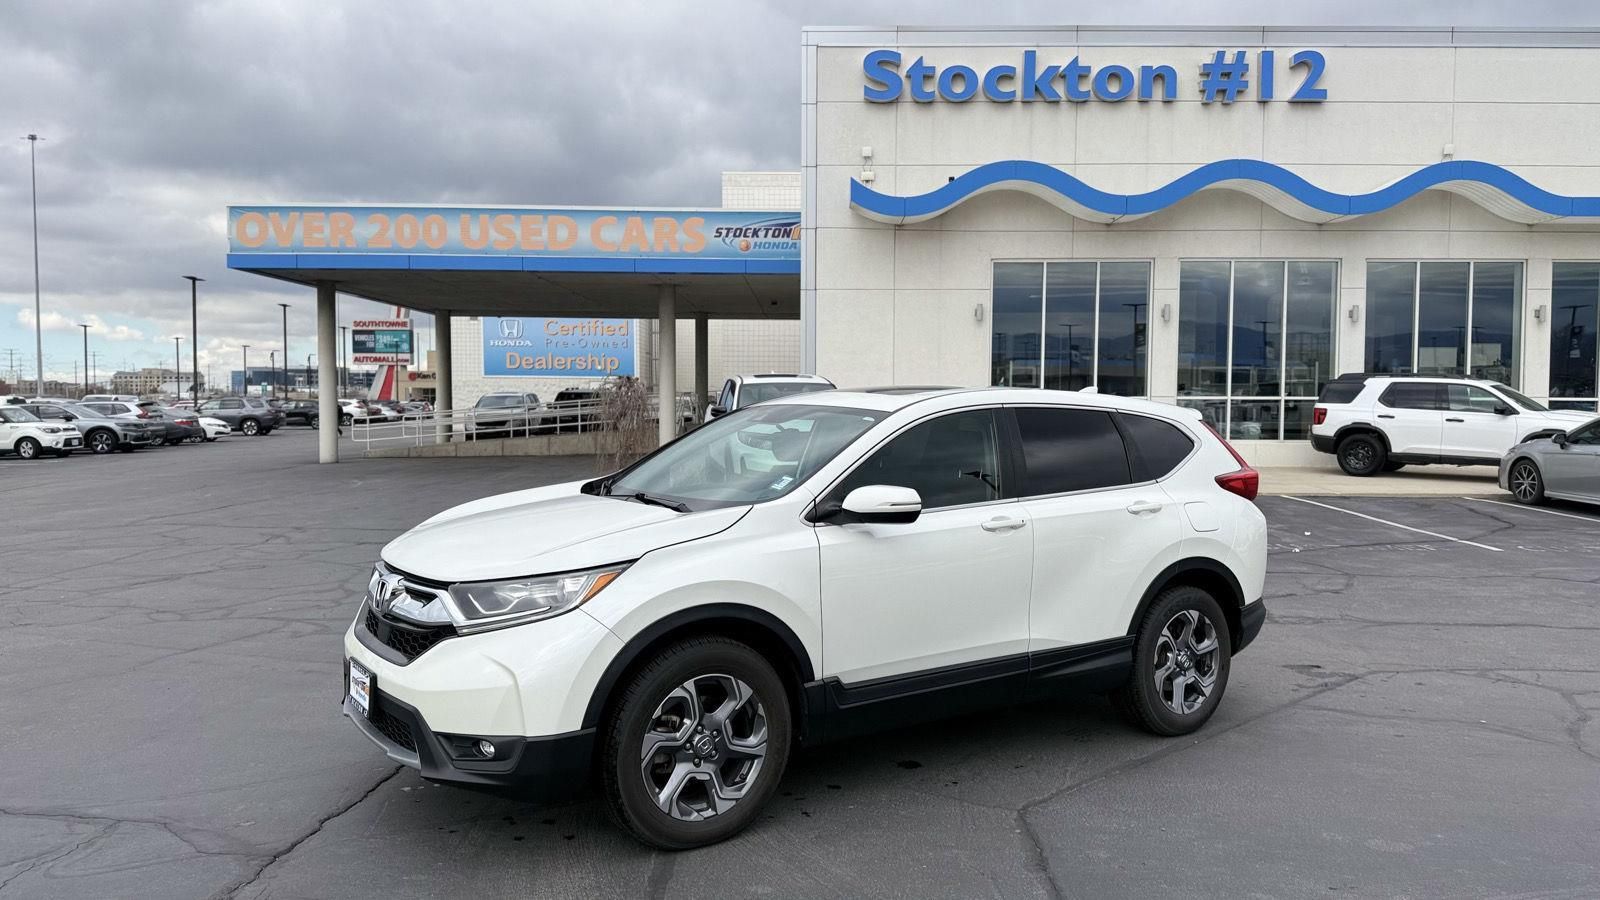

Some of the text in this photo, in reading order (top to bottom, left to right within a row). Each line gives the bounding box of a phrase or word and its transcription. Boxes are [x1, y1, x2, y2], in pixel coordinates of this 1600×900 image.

[863, 50, 1328, 104] Stockton #12
[235, 211, 705, 253] OVER 200 USED CARS
[713, 227, 793, 239] STOCKTON
[752, 241, 798, 251] HONDA
[353, 320, 409, 328] SOUTHTOWNE
[543, 319, 630, 337] Certified
[489, 338, 533, 347] HONDA
[545, 338, 629, 349] Pre-Owned
[505, 352, 620, 373] Dealership
